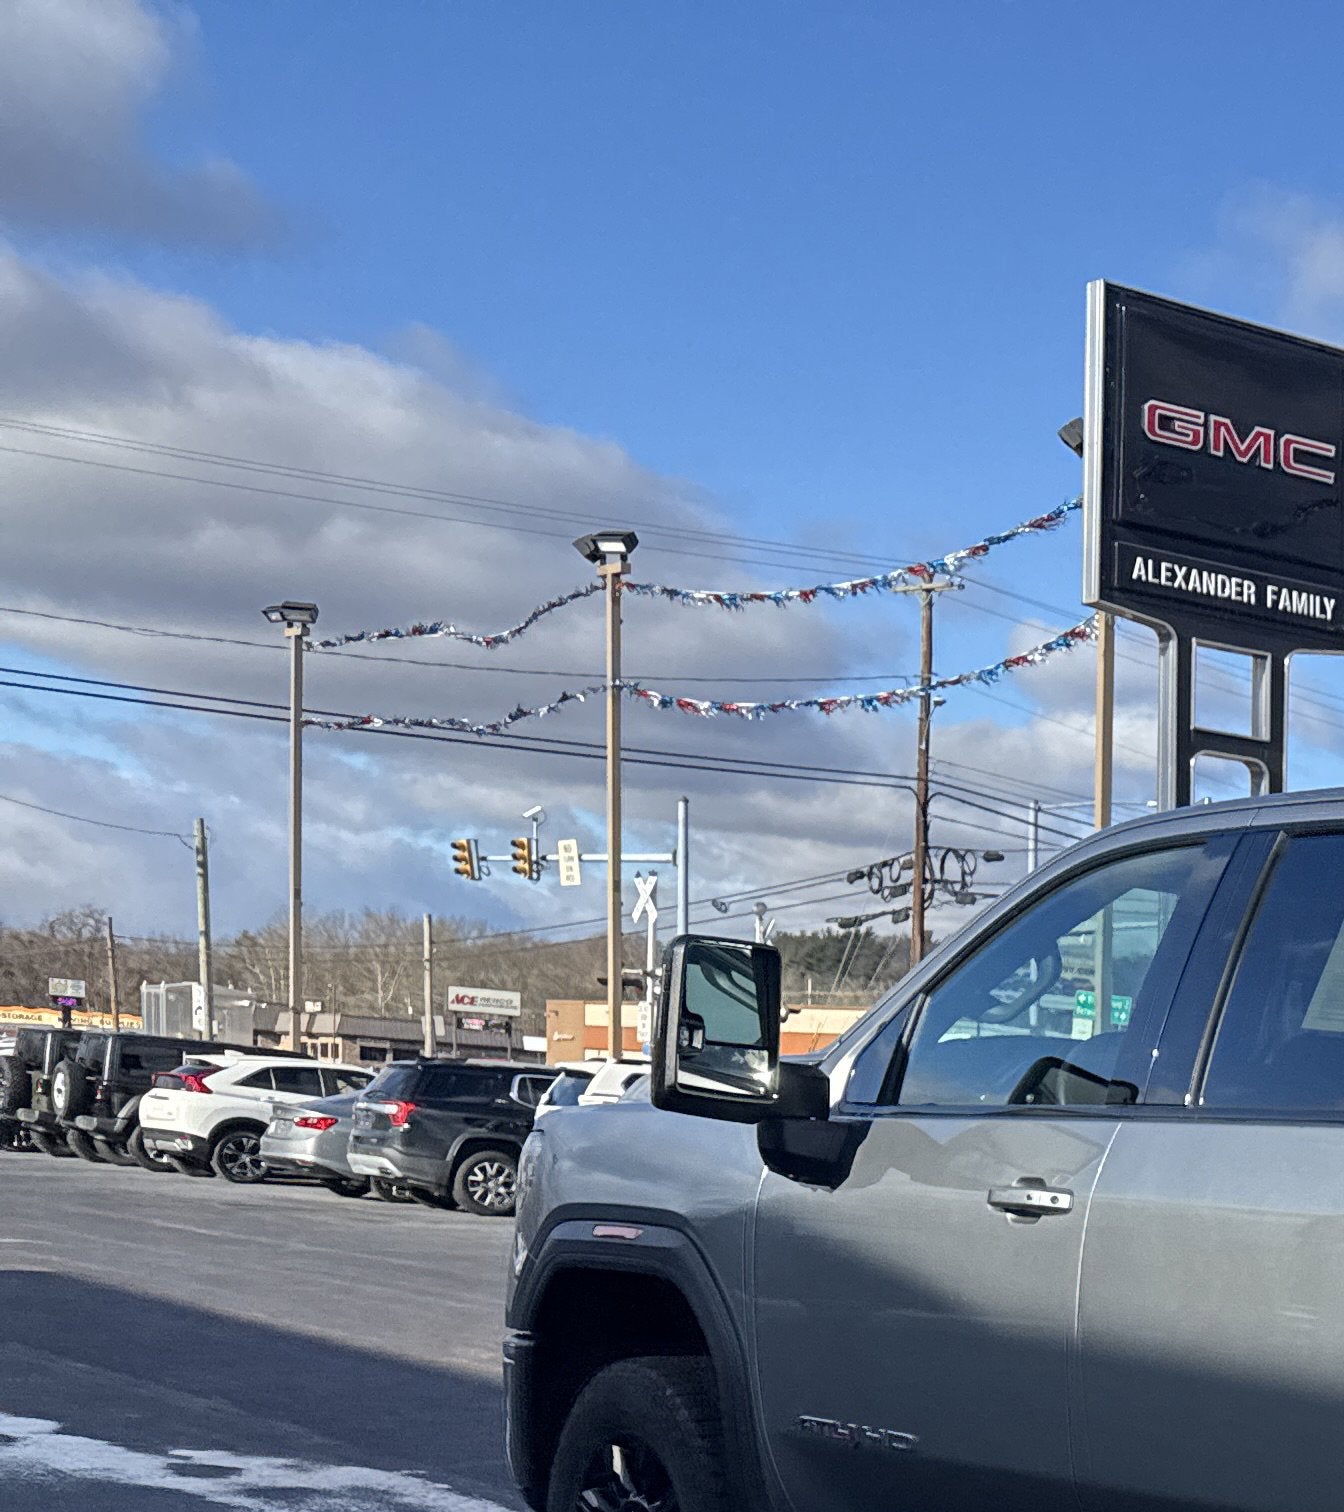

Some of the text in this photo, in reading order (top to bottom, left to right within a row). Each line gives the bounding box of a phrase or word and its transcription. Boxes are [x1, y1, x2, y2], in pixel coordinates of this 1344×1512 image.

[1143, 398, 1337, 485] GMC
[1132, 556, 1336, 622] ALEXANDER FAMILY
[450, 993, 479, 1006] ACE
